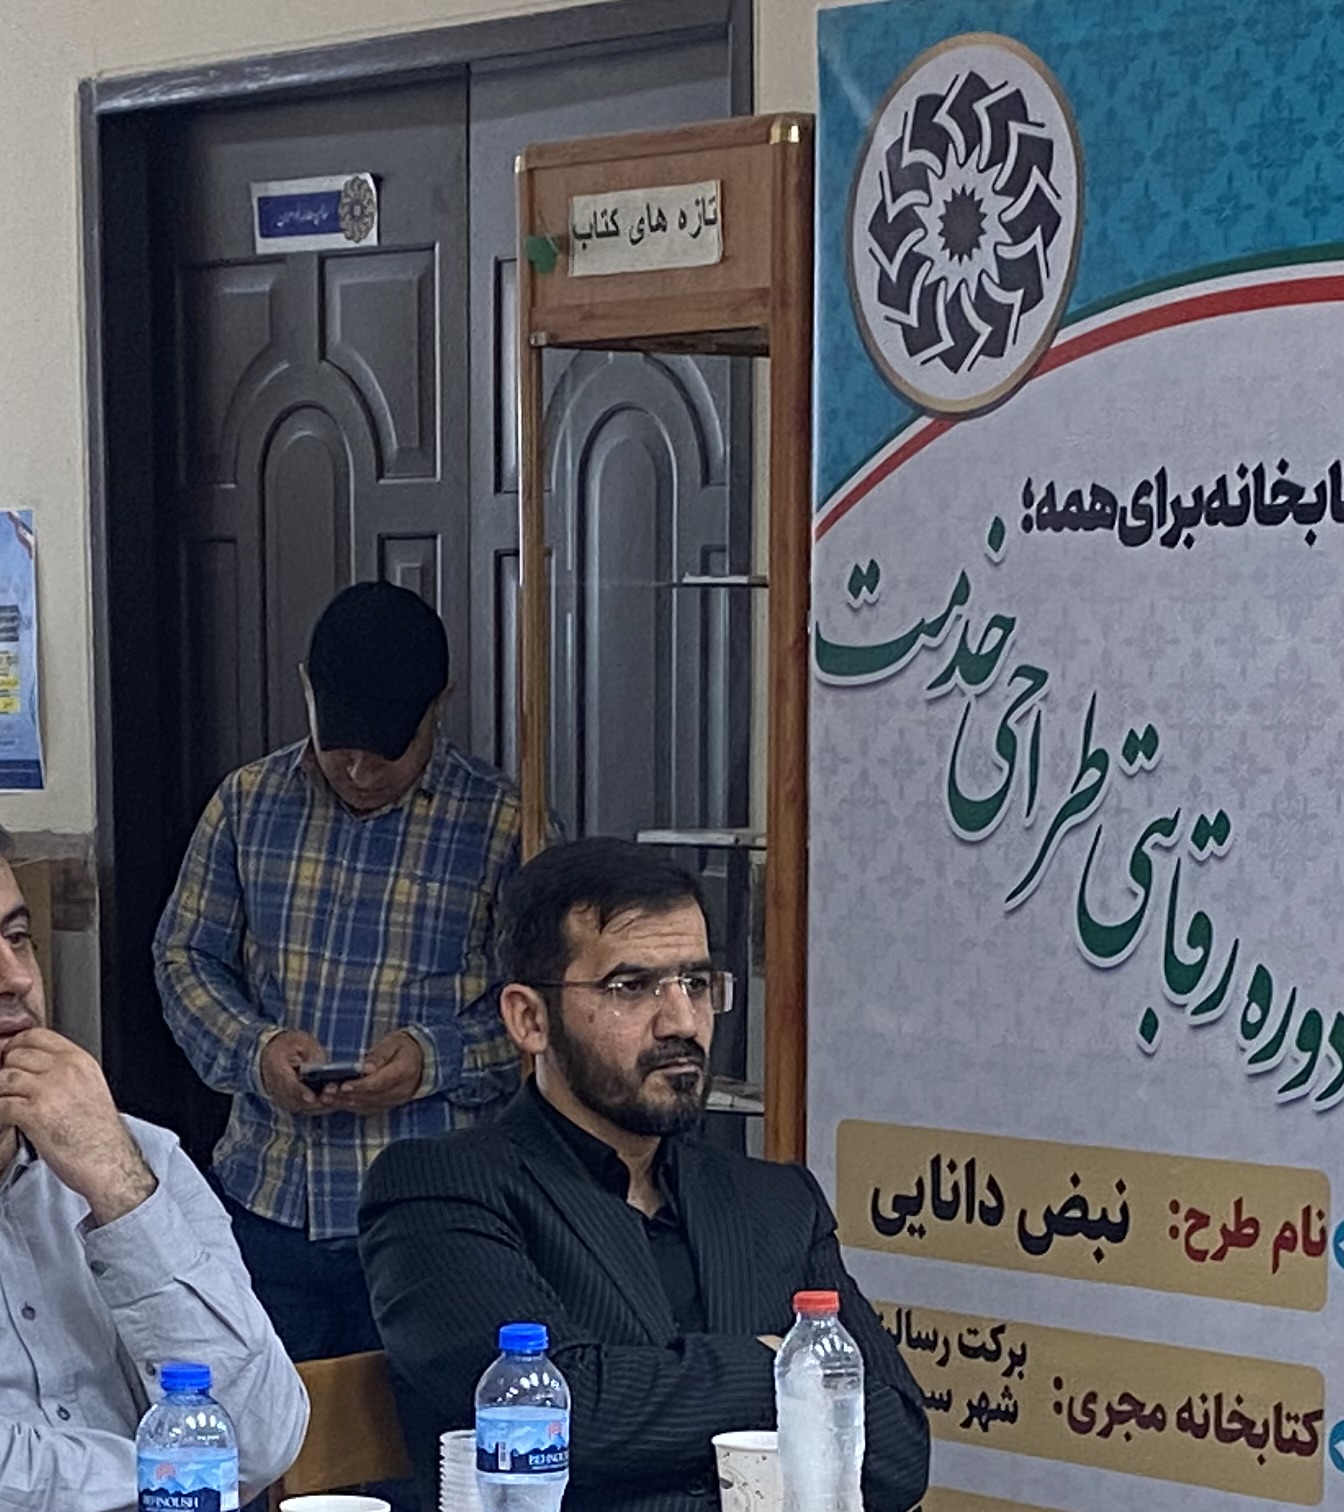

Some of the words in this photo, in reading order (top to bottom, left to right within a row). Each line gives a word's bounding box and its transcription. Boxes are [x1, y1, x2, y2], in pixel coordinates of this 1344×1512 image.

[571, 207, 620, 251] کتاب
[628, 202, 668, 246] های
[679, 195, 718, 240] تازه
[1118, 465, 1204, 549] برای
[813, 515, 1017, 692] خدمت
[947, 664, 1111, 904] طراحی
[870, 1153, 1005, 1241] دانایی
[1017, 1172, 1131, 1265] نبض
[1168, 1197, 1259, 1264] طرح:
[1272, 1204, 1327, 1274] نام
[880, 1307, 951, 1368] رسال
[957, 1324, 1027, 1381] برکت
[959, 1384, 1019, 1433] شهر
[1053, 1375, 1166, 1442] مجری:
[1175, 1393, 1324, 1466] کتابخانه
